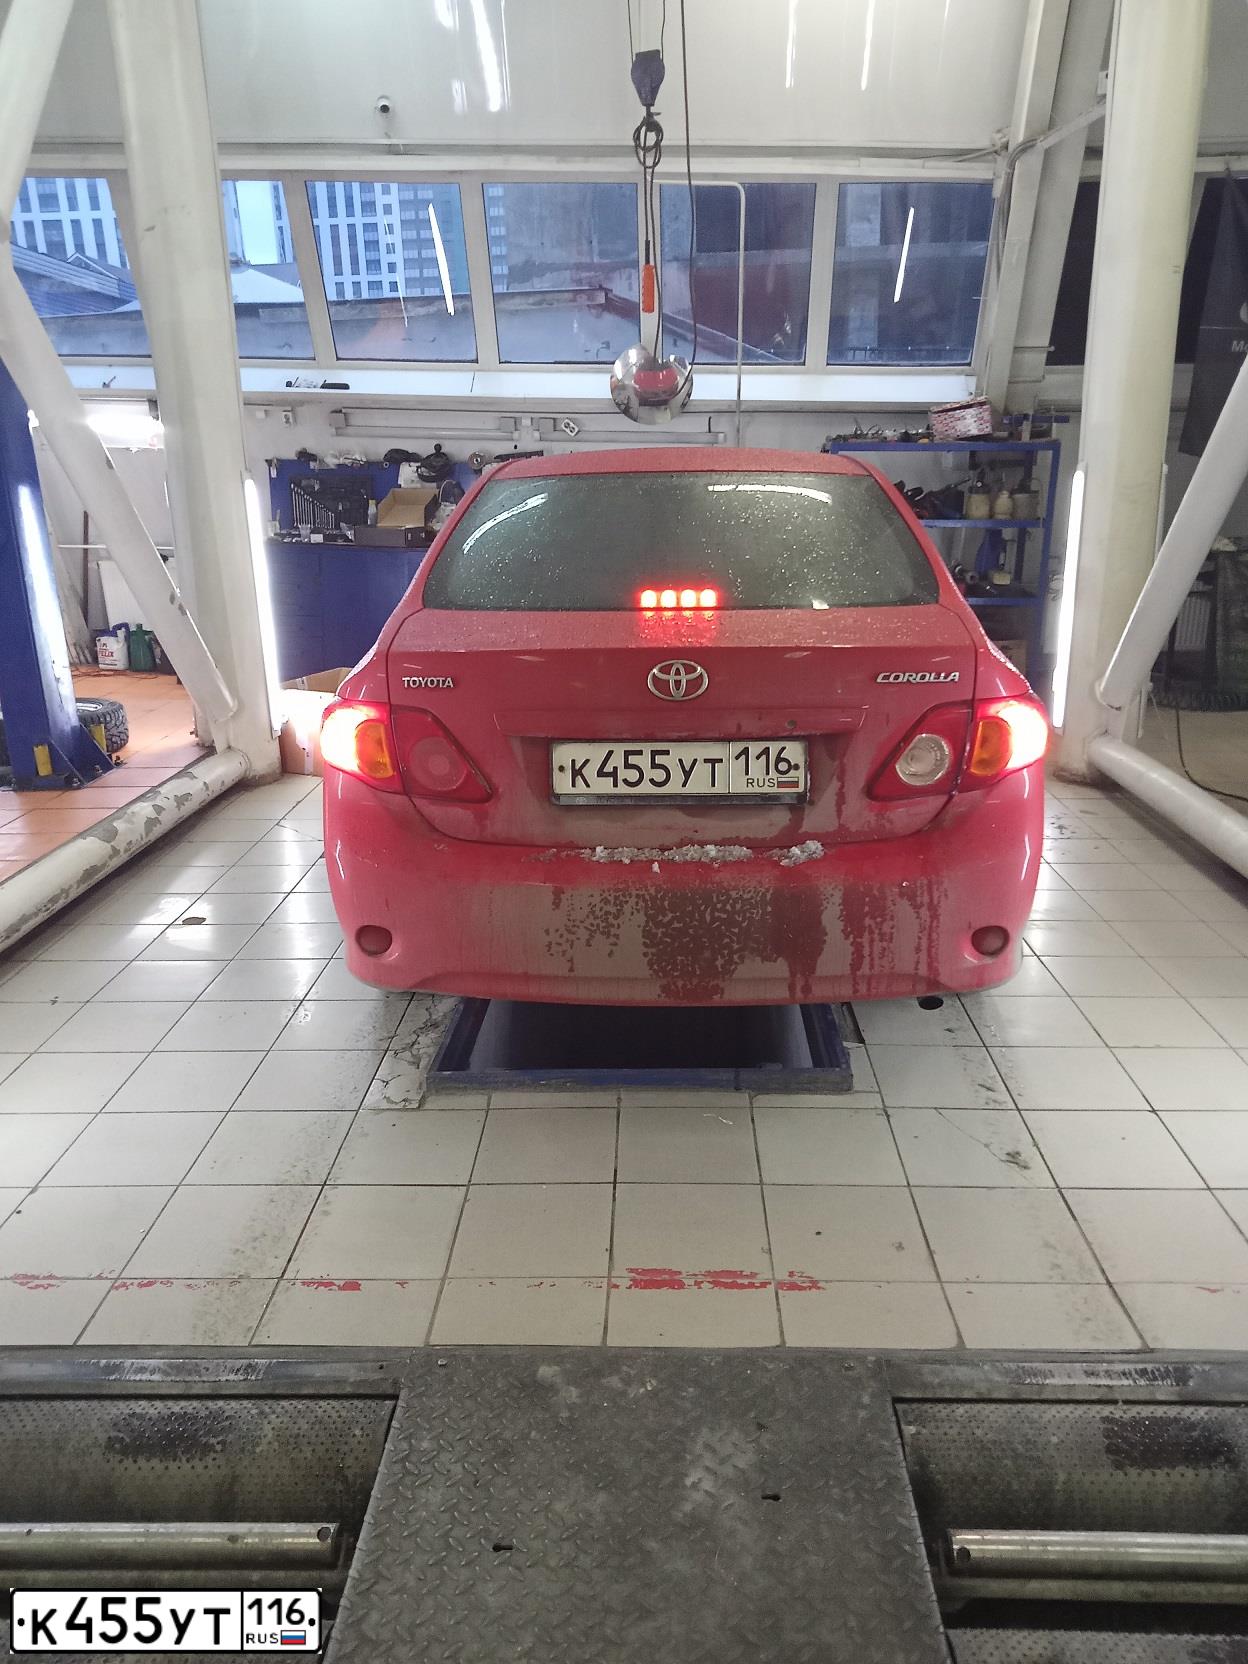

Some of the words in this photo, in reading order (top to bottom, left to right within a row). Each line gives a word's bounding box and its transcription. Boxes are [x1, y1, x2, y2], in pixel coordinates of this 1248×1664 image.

[402, 677, 454, 688] TOYOTA
[876, 672, 960, 683] COROLLA
[734, 746, 792, 776] 116
[746, 778, 776, 788] RUS
